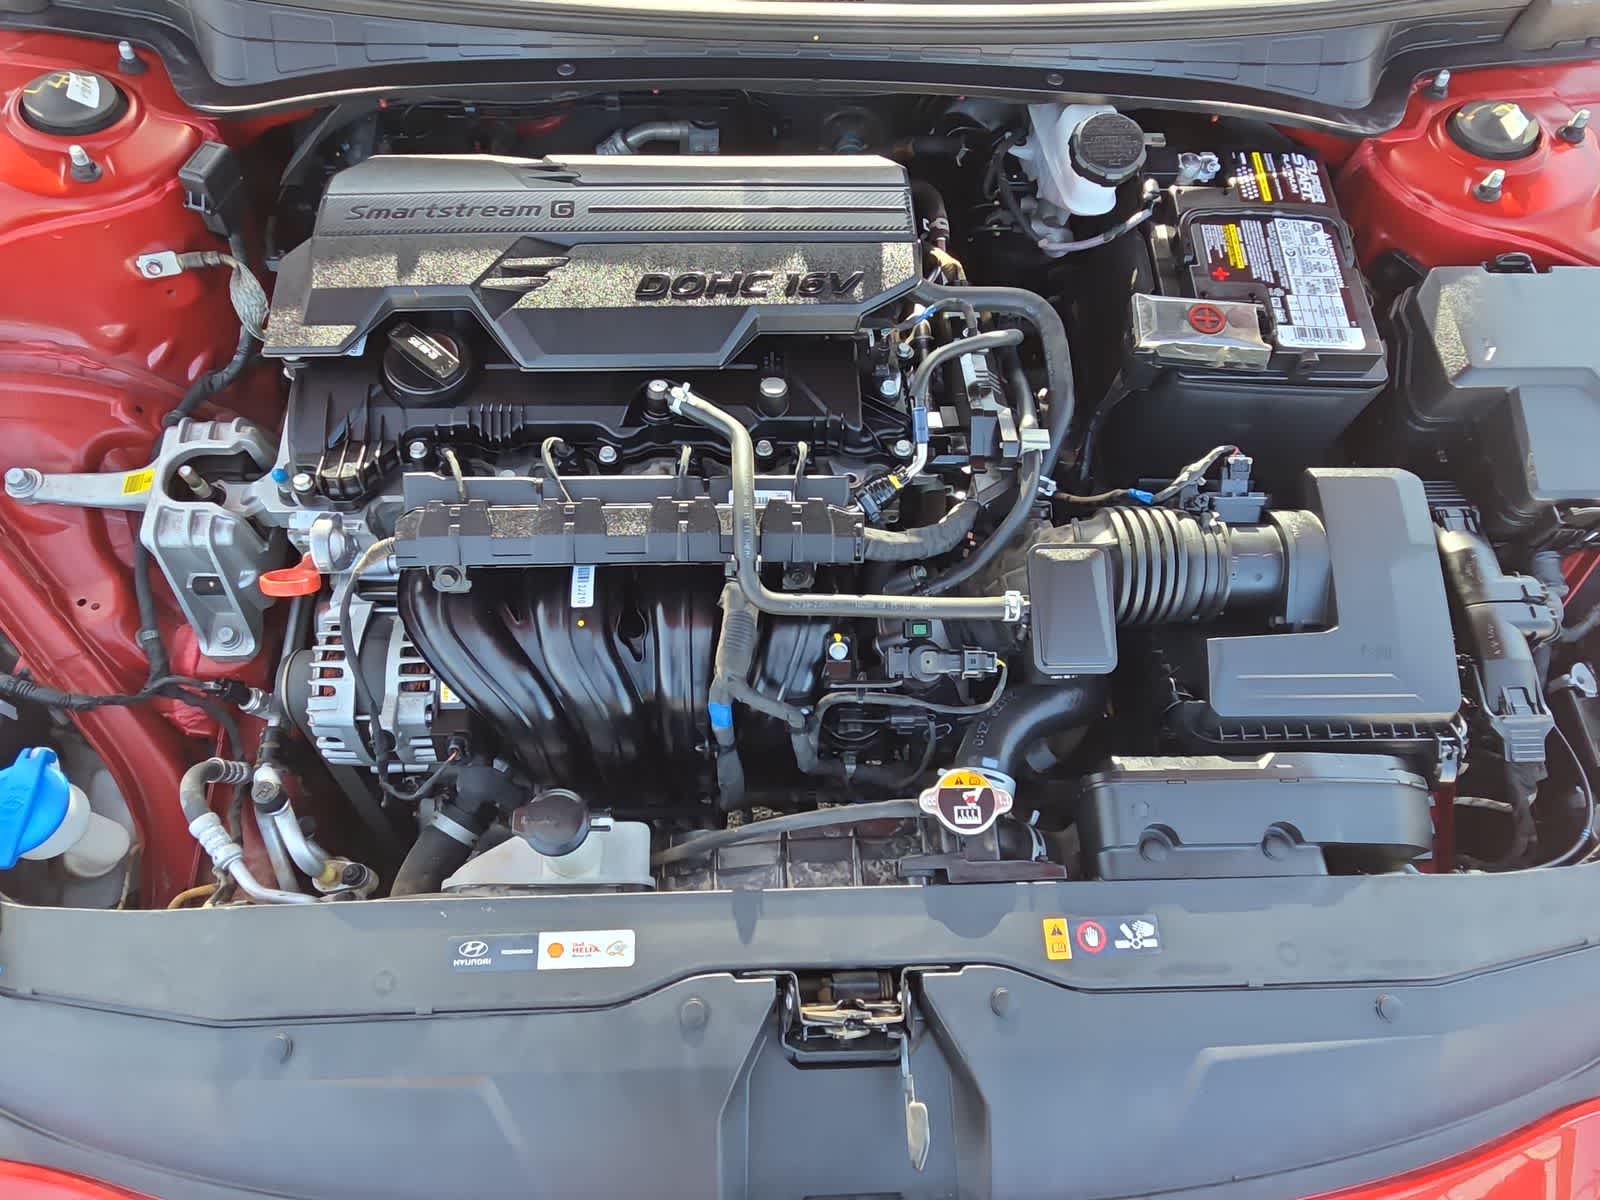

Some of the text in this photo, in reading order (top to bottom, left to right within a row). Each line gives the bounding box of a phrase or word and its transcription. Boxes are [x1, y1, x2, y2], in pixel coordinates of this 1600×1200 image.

[1281, 153, 1299, 194] PLATINUM
[1308, 160, 1327, 203] SUPER
[345, 201, 574, 221] Smartstream G
[635, 271, 865, 300] DOHC 16V
[572, 943, 601, 953] HELIX
[453, 958, 492, 967] HYUNDAI
